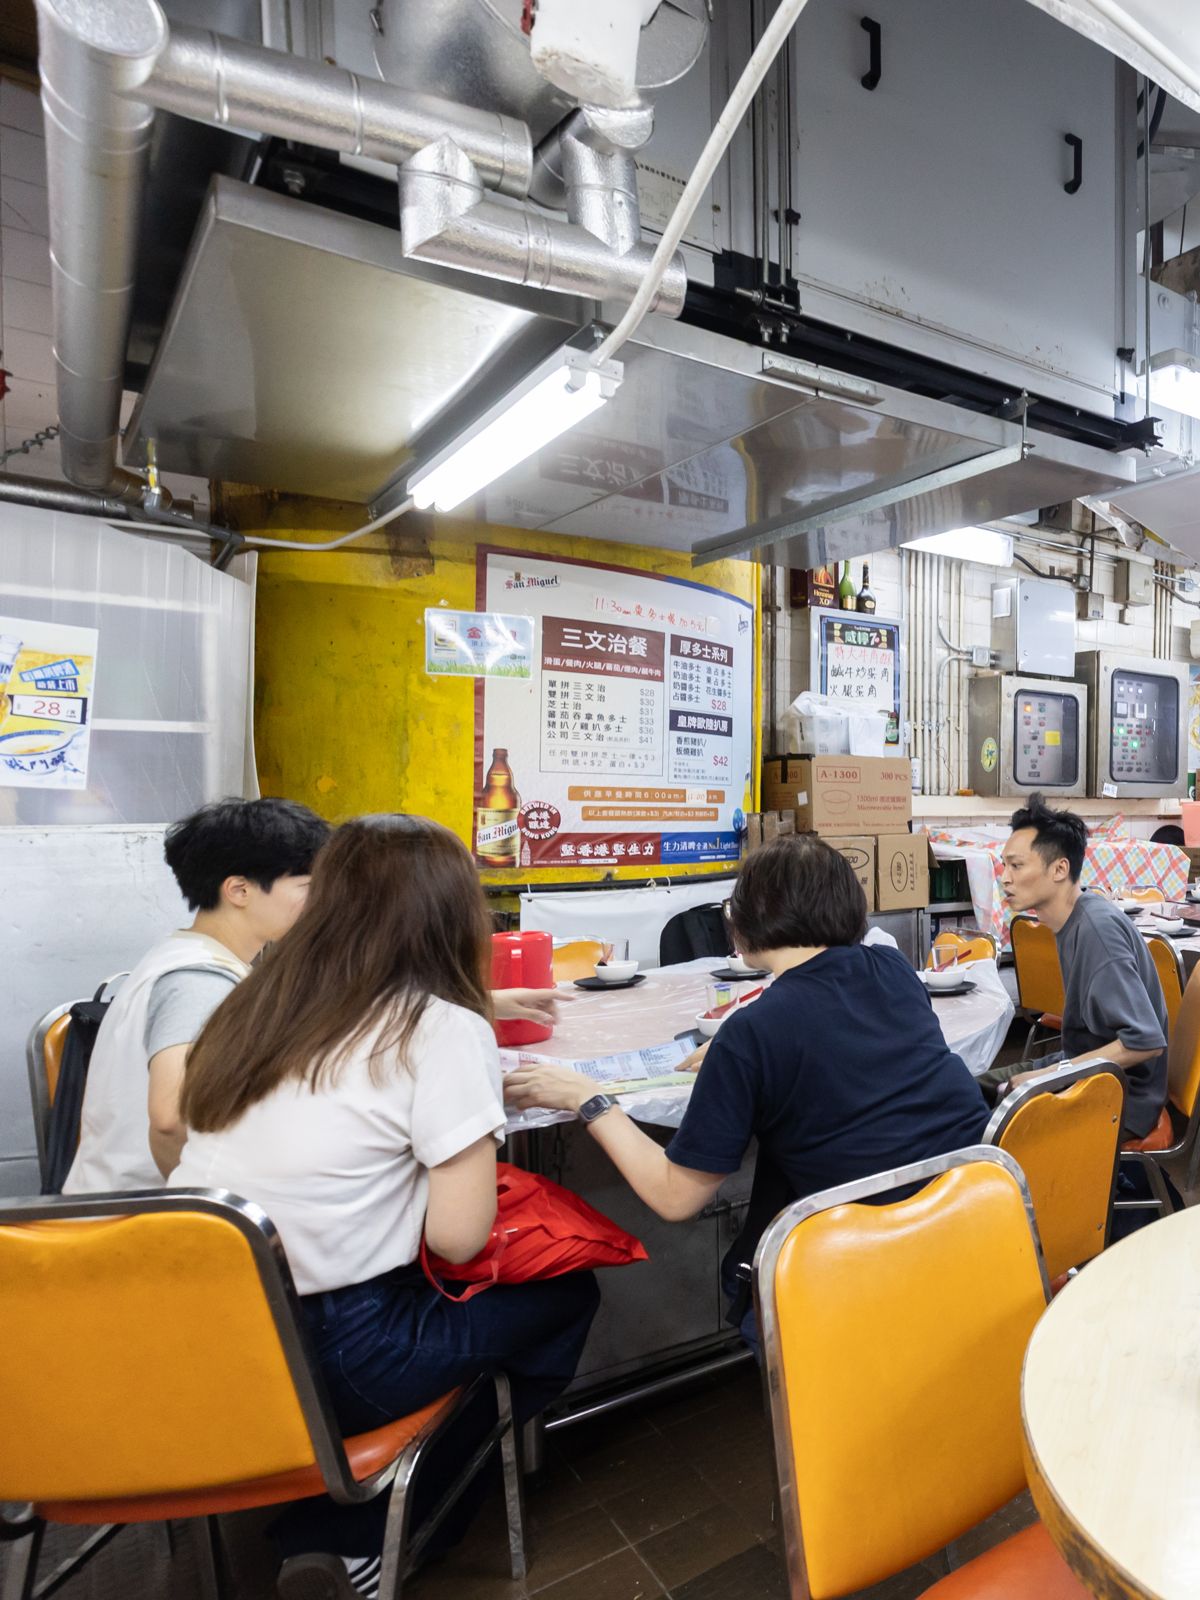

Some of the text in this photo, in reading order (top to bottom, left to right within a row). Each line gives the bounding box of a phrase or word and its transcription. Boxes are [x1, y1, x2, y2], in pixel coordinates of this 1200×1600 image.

[505, 575, 558, 589] San Miguel
[560, 627, 648, 657] 三文治餐
[679, 640, 728, 663] 厚多士系列
[33, 700, 61, 717] 28
[713, 755, 729, 767] $42
[880, 772, 894, 780] 300
